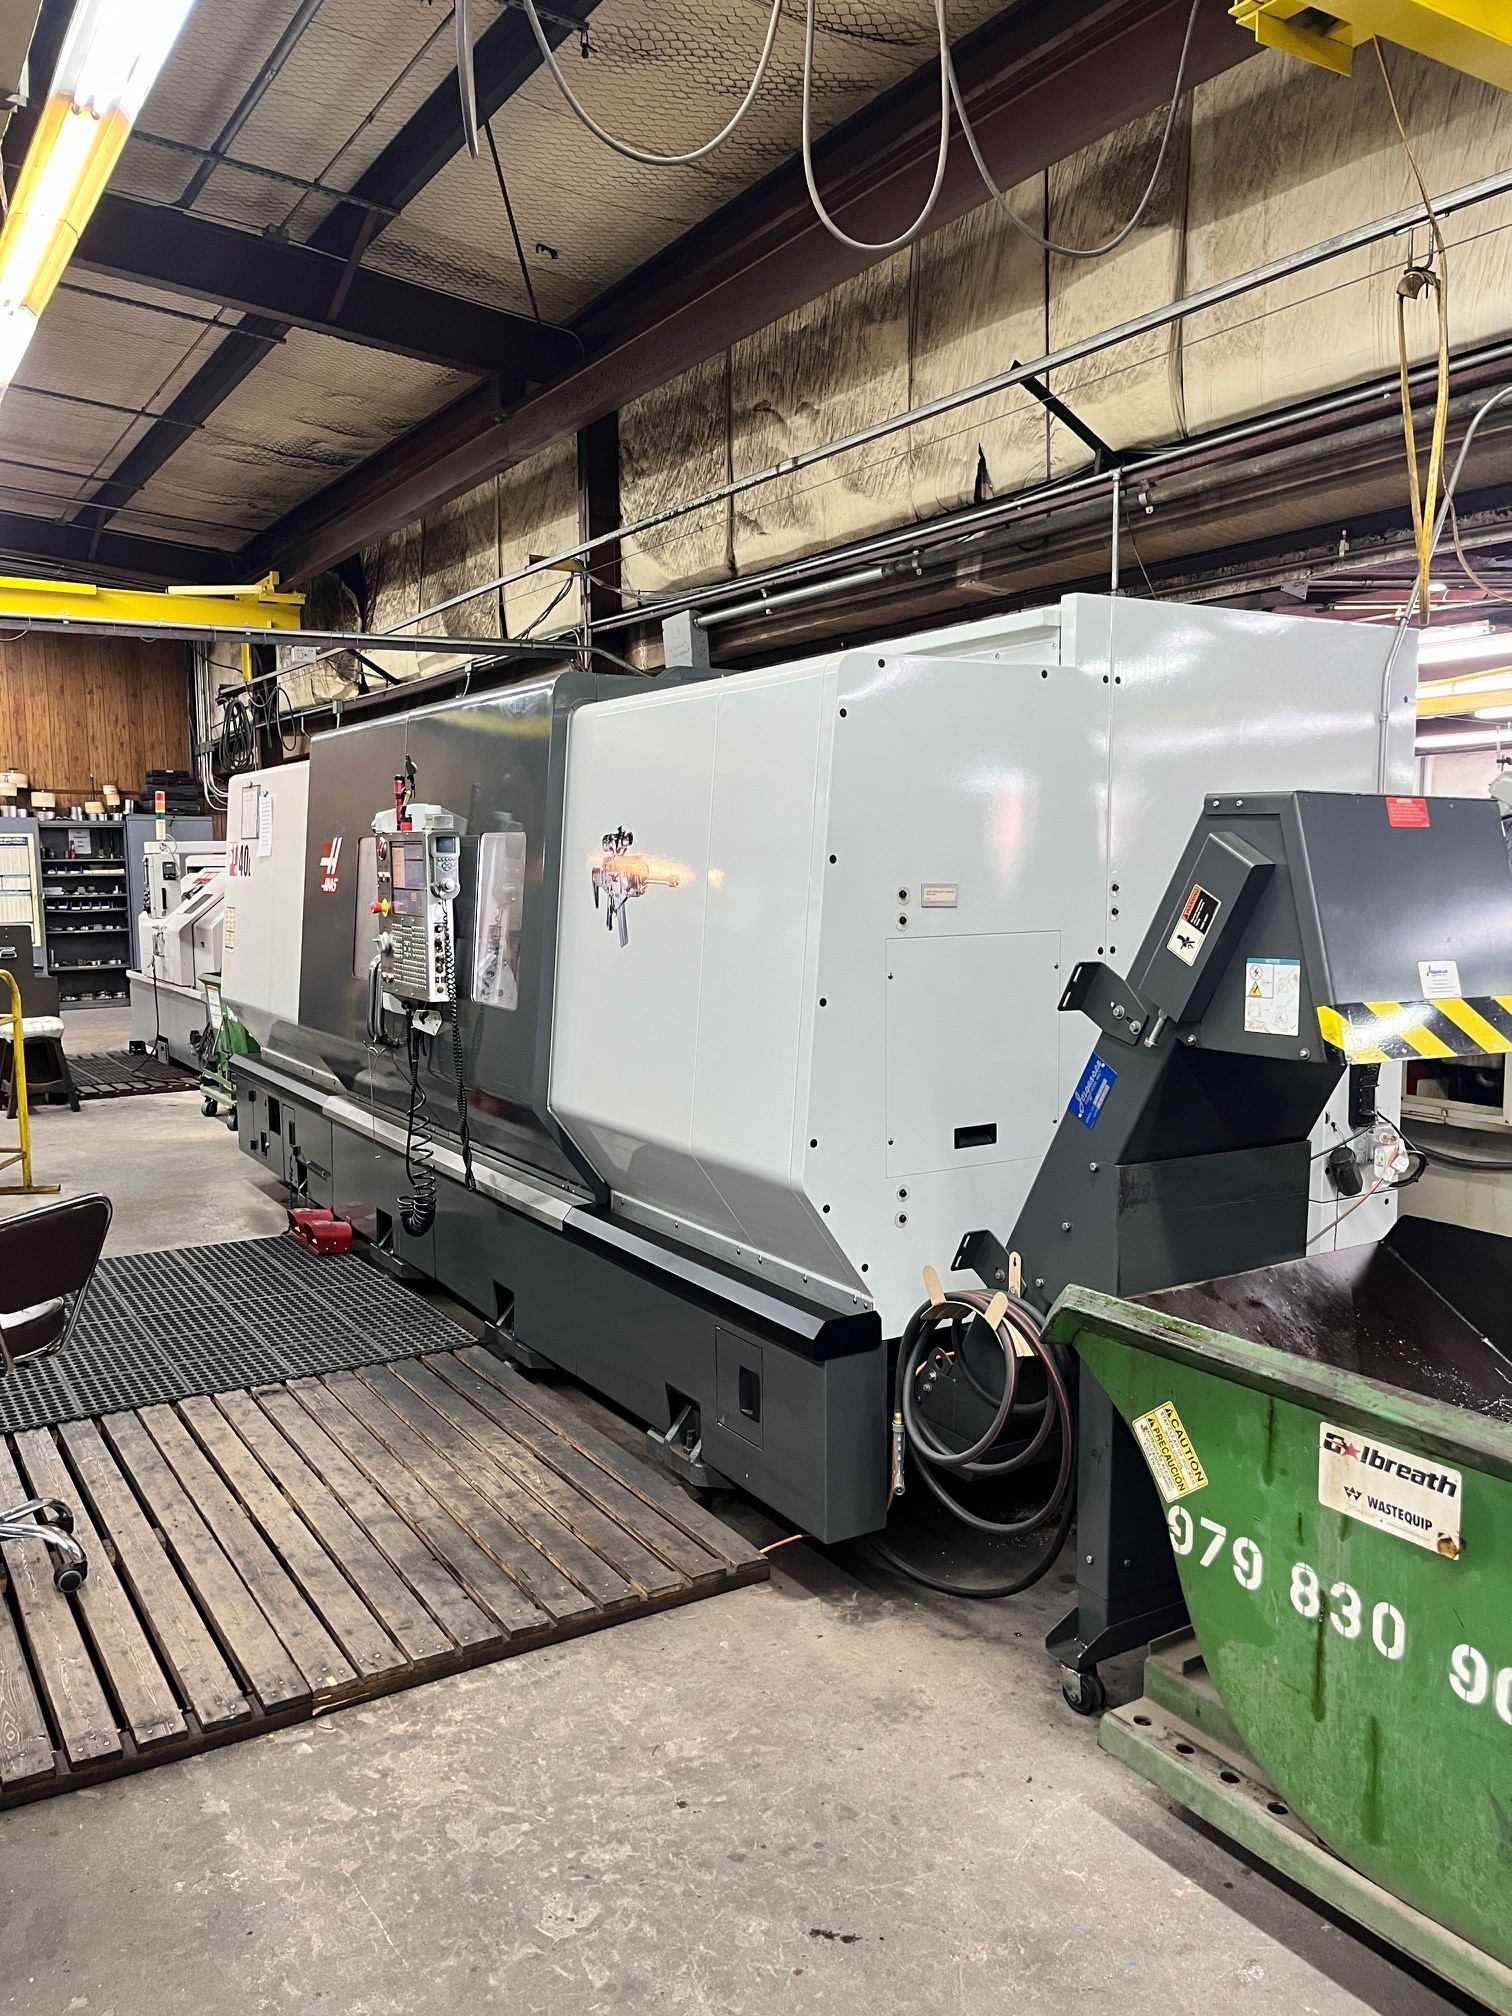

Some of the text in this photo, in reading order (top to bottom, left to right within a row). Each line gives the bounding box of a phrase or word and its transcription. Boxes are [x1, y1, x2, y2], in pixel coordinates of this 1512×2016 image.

[1170, 1418, 1204, 1482] CAUTION
[1367, 1495, 1433, 1531] WASTEQUIP
[1167, 1505, 1263, 1590] 979
[1290, 1562, 1406, 1660] 830
